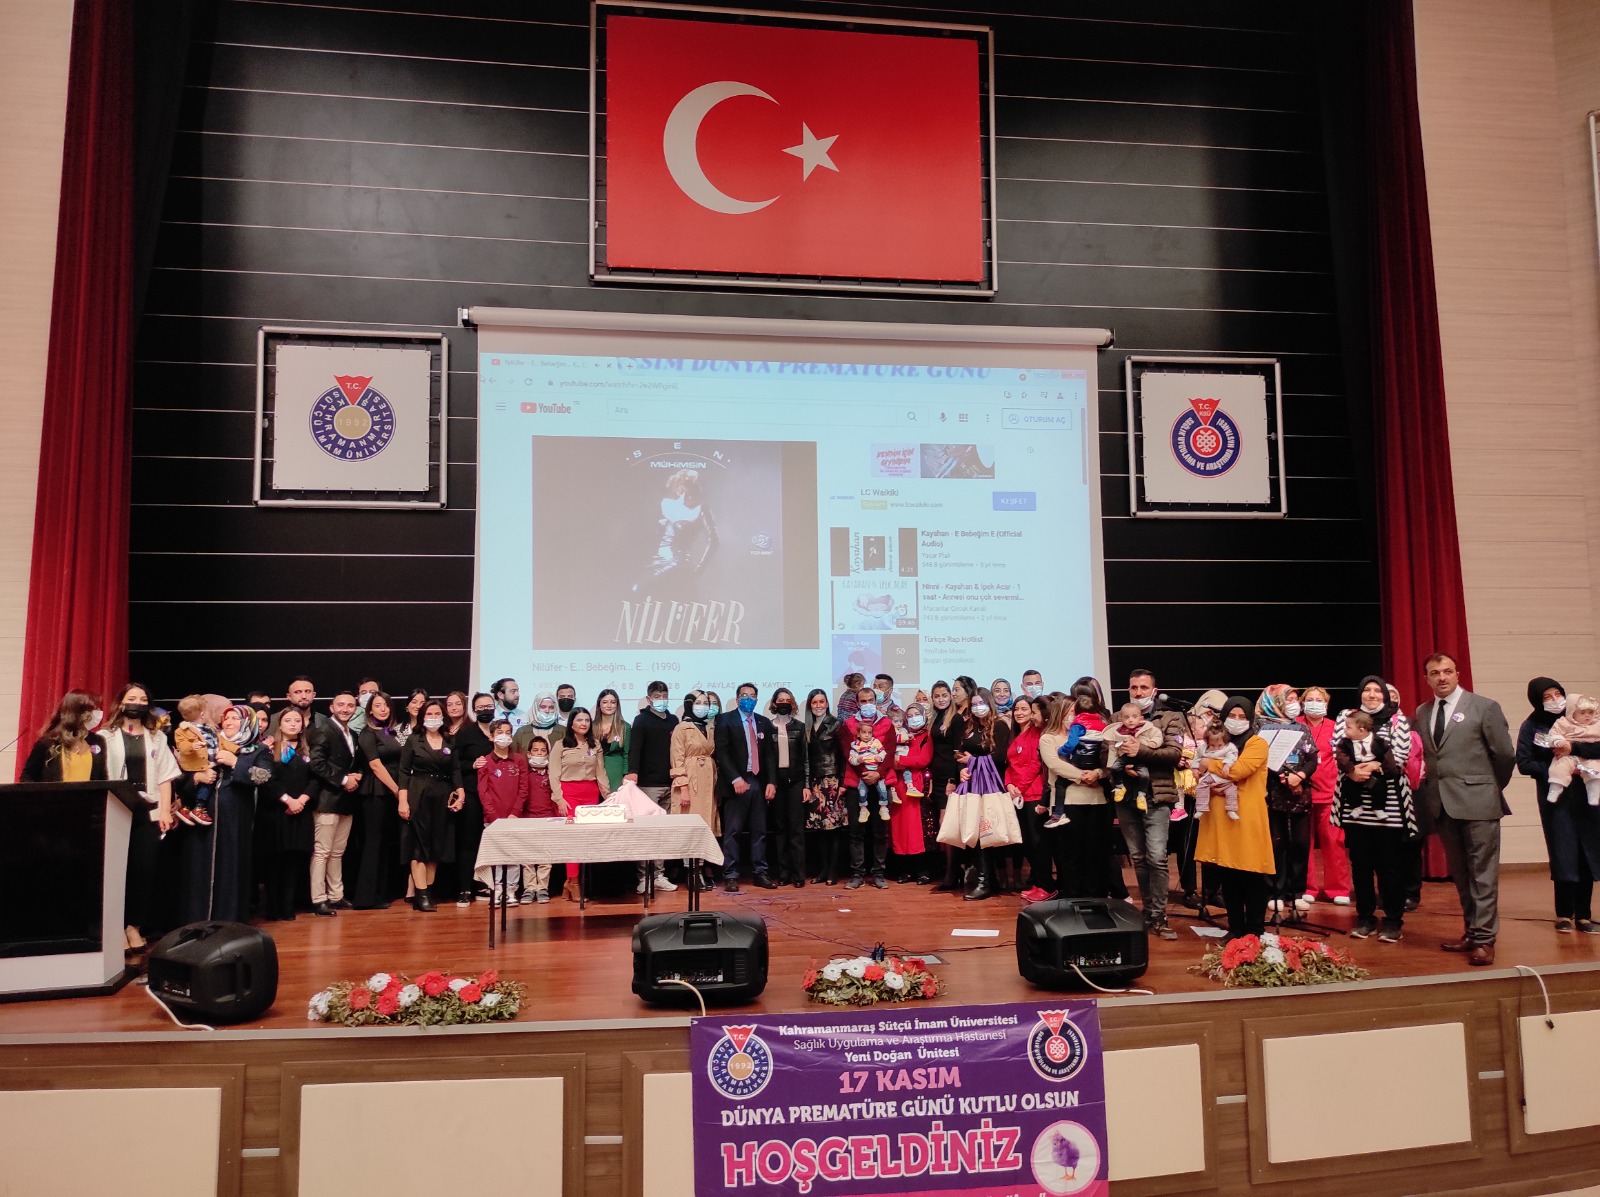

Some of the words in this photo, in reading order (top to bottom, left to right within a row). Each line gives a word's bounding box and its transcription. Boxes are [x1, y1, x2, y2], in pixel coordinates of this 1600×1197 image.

[345, 382, 361, 390] T.C.
[538, 402, 572, 414] YouTube
[614, 405, 629, 414] Ara
[339, 418, 368, 426] 1992
[1023, 415, 1055, 424] OTURUM
[1055, 416, 1067, 425] AÇ
[860, 488, 871, 496] LC
[873, 488, 899, 497] Waikiki
[921, 530, 950, 539] Kayahan
[961, 530, 990, 539] Bebeğim
[921, 540, 944, 549] Audio)
[945, 583, 973, 591] Kayahan
[613, 596, 745, 645] NİLÜFER
[924, 635, 946, 644] Türkçe
[947, 636, 960, 644] Rap
[895, 647, 906, 655] 50
[532, 661, 563, 672] Nilüfer
[651, 661, 681, 673] (1990)
[707, 682, 736, 691] PAYLAŞ
[779, 1024, 876, 1035] Kahramanmaraş
[878, 1020, 912, 1032] Sütçü
[914, 1018, 948, 1029] İmam
[950, 1015, 1018, 1028] Üniversitesi
[794, 1038, 826, 1051] Sağlık
[829, 1037, 884, 1050] Uygulama
[902, 1035, 953, 1046] Araştırma
[955, 1029, 1007, 1041] Hastanesi
[844, 1051, 871, 1062] Yeni
[873, 1050, 912, 1062] Doğan
[917, 1046, 960, 1059] Ünitesi
[838, 1071, 869, 1093] 17
[876, 1066, 961, 1092] KASIM
[721, 1105, 785, 1126] DÜNYA
[789, 1098, 897, 1123] PREMATÜRE
[901, 1094, 955, 1117] GÜNÜ
[958, 1094, 1017, 1114] KUTLU
[1021, 1090, 1079, 1109] OLSUN
[721, 1118, 1022, 1194] HOŞGELDİNİZ
